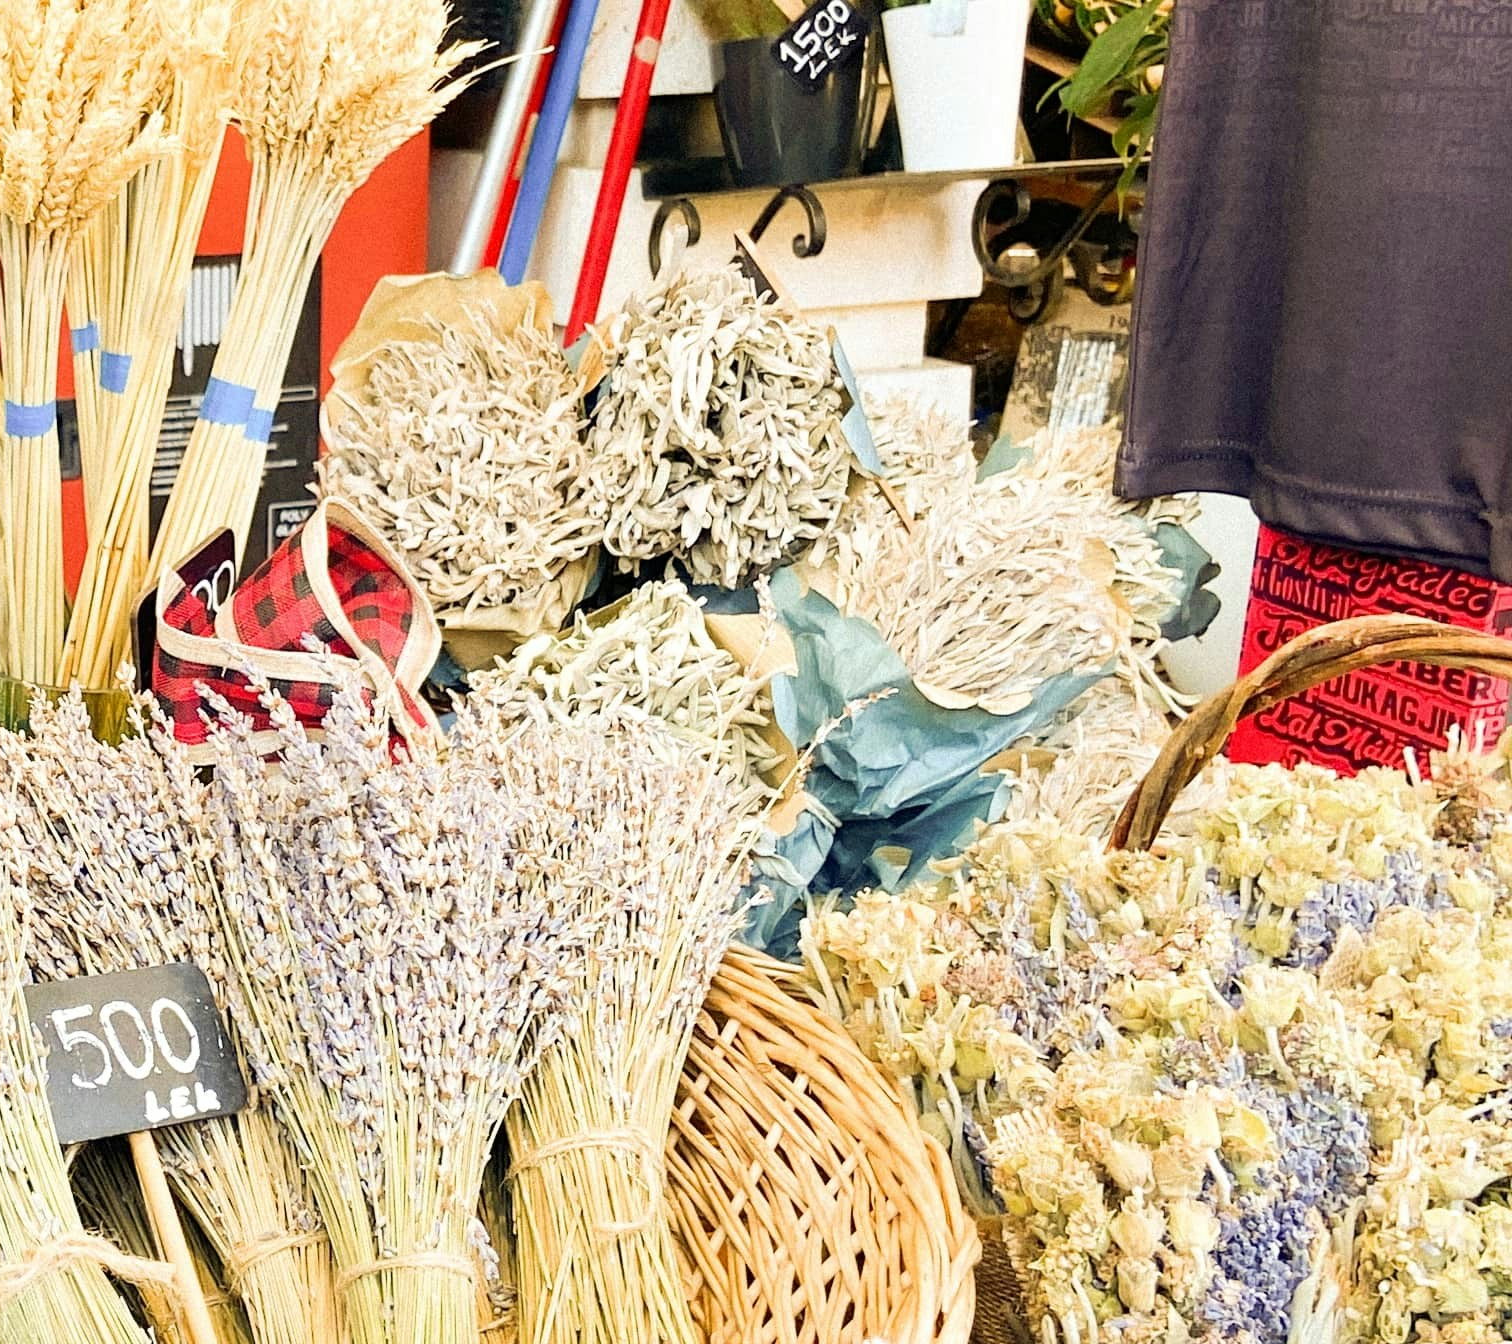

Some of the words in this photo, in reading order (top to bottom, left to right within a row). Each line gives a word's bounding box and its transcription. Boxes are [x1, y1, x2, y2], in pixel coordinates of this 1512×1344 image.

[807, 28, 857, 81] LEK
[1375, 658, 1492, 702] IBER
[51, 997, 202, 1089] 500
[143, 1080, 221, 1125] LEK
